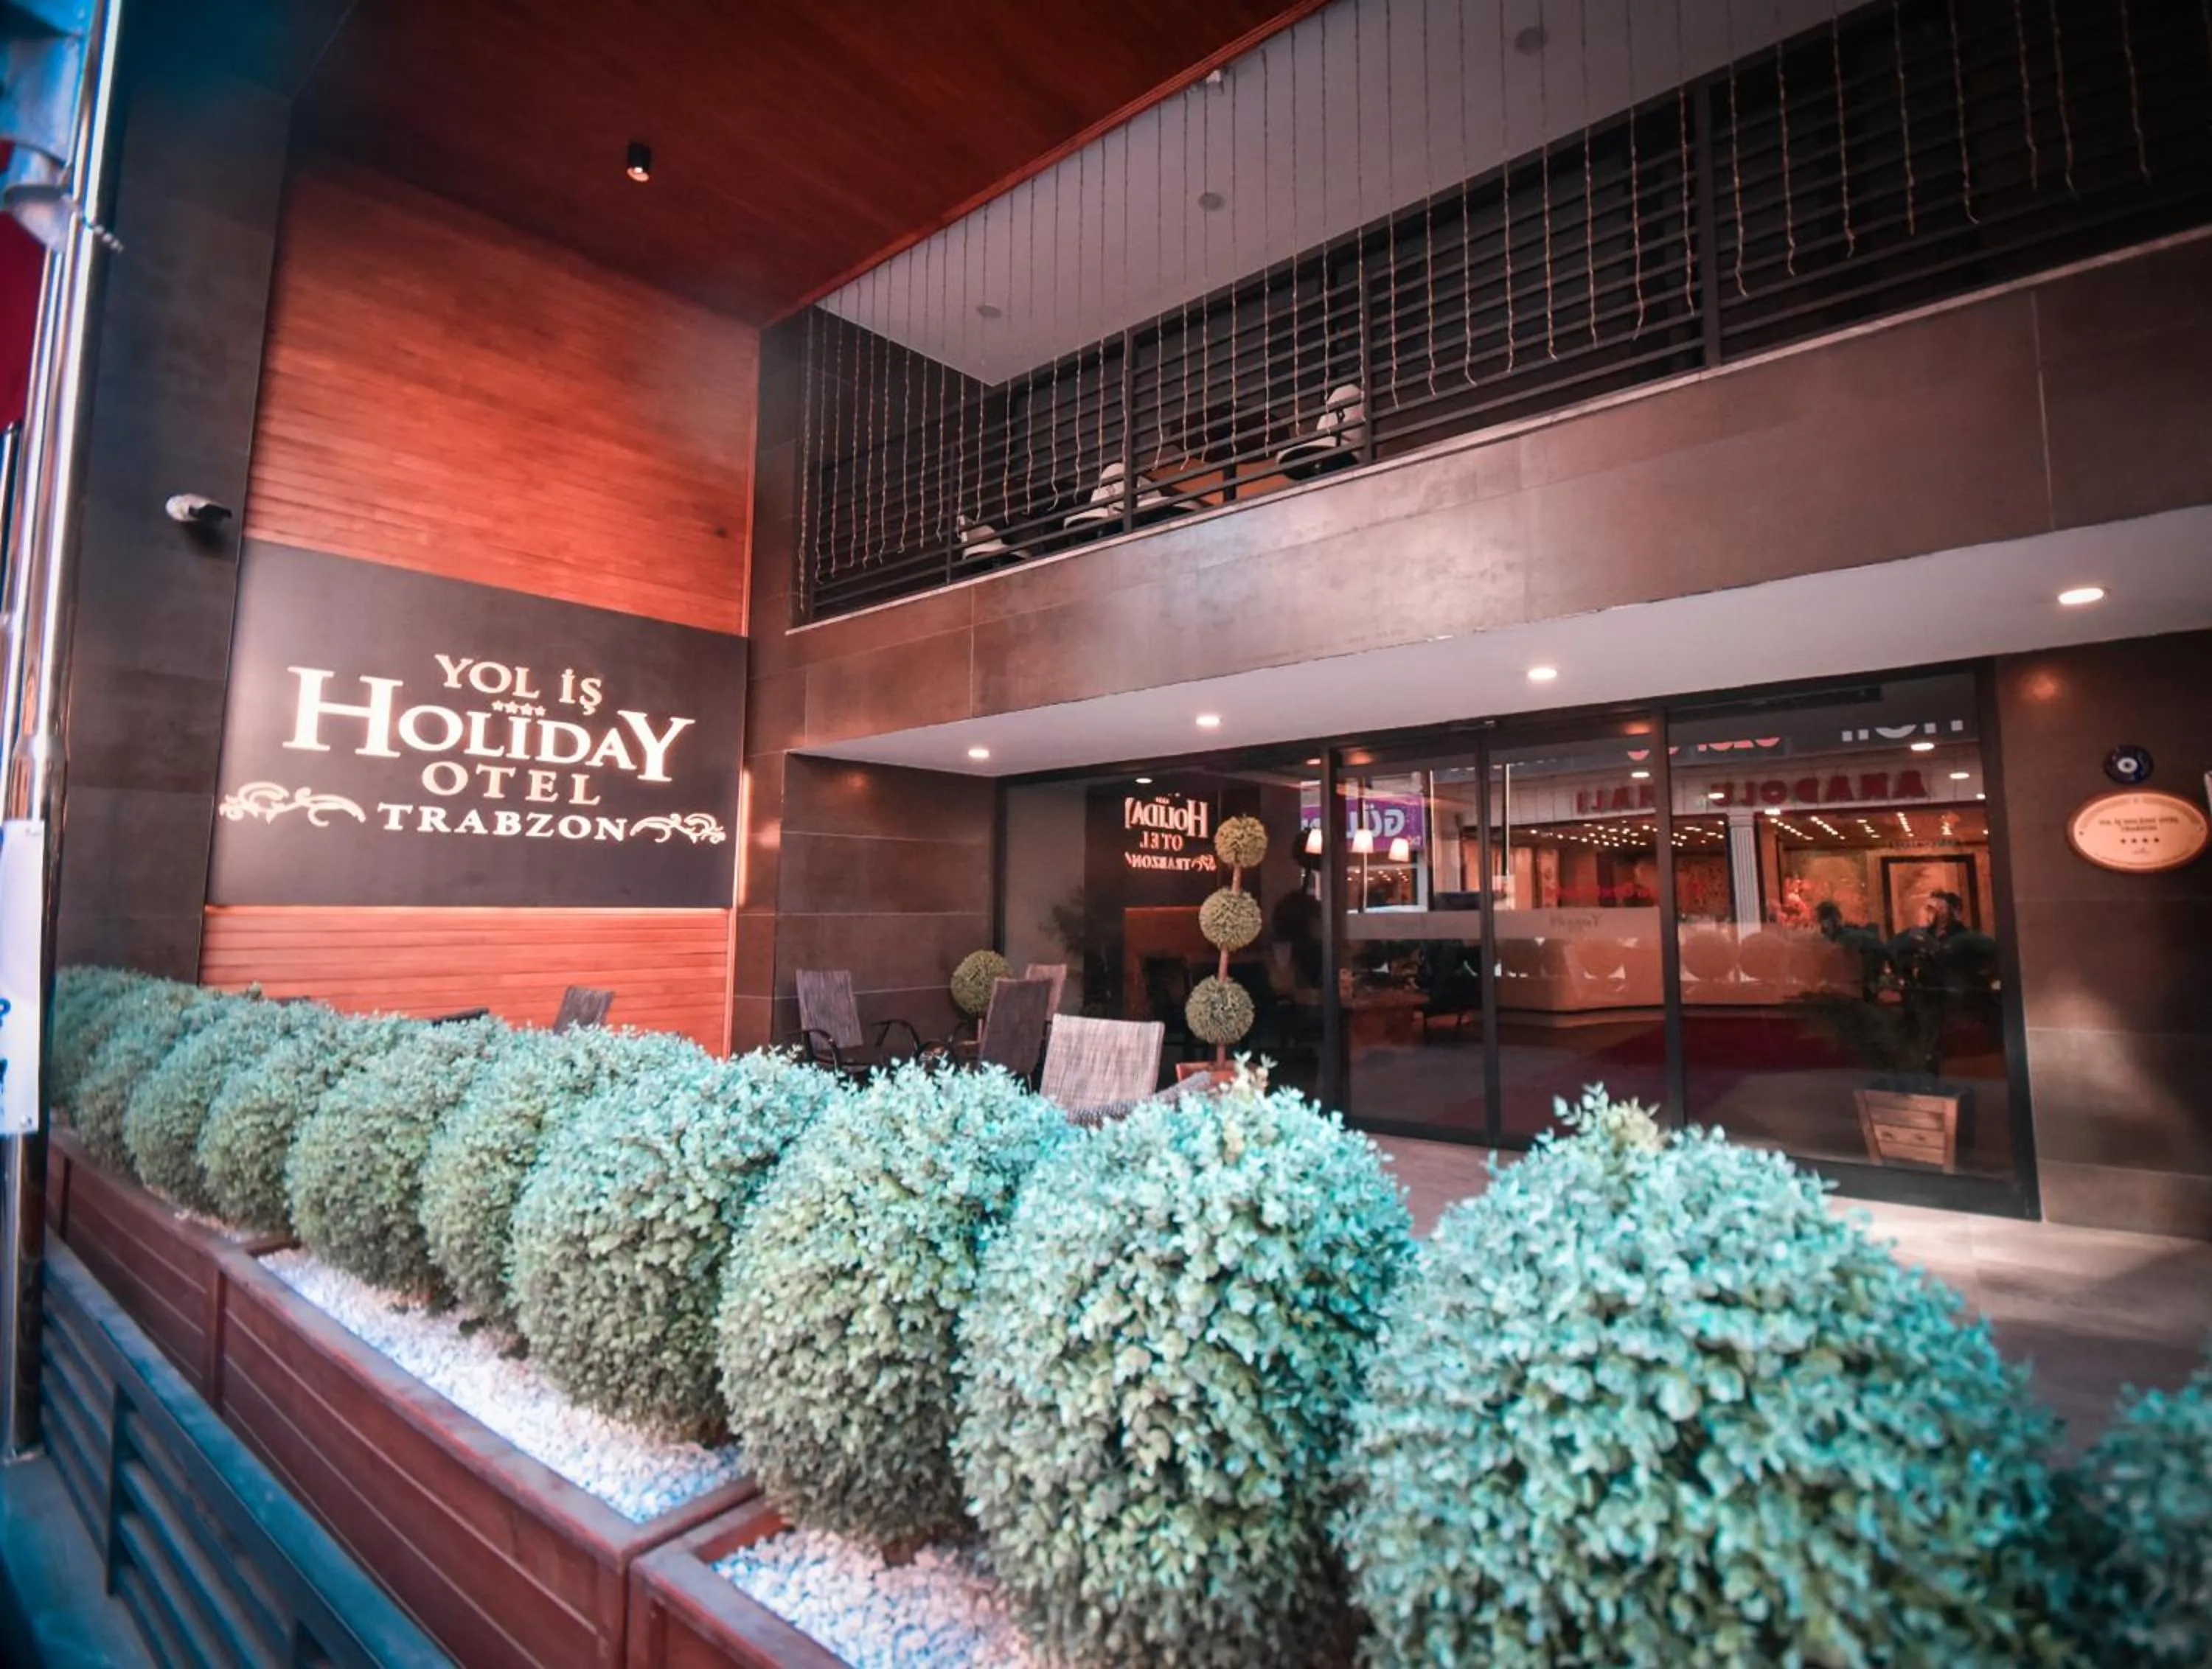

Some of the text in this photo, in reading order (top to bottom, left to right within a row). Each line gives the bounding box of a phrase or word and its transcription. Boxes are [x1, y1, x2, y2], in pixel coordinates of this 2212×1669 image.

[434, 654, 602, 716] YOL İŞ
[282, 666, 695, 782] HOLIDAY
[422, 762, 601, 806] OTEL
[377, 801, 627, 842] TRABZON
